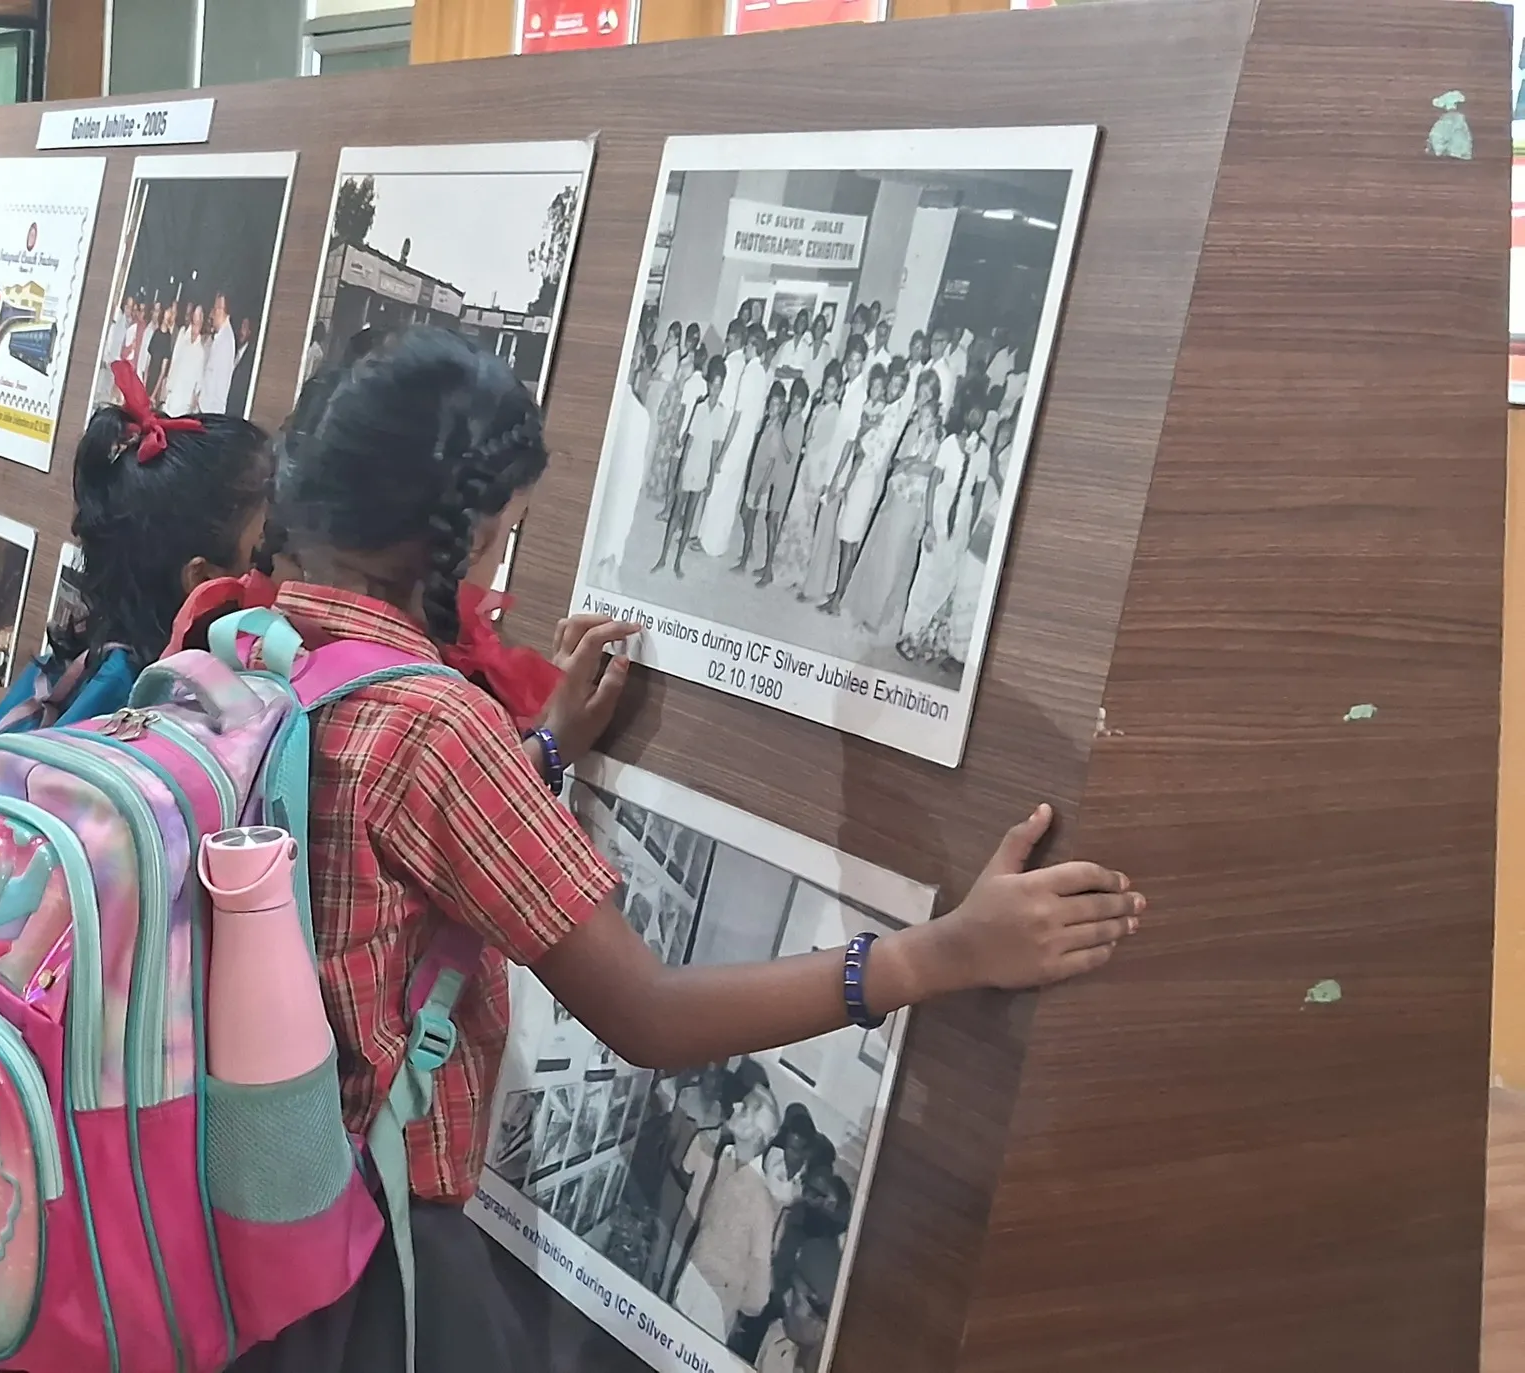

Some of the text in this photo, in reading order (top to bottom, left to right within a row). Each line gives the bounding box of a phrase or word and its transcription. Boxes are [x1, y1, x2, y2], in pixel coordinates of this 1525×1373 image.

[71, 117, 101, 140] Golden
[101, 114, 134, 139] Jubilee
[142, 111, 169, 137] 2005
[775, 215, 805, 230] SILVER
[734, 231, 855, 261] PHOTOGRAPHIC EXHIBITION
[582, 593, 950, 722] A view of the visitors during ICF Silver Jubilee Exhibition
[708, 660, 784, 701] 02.10.1980
[523, 1224, 574, 1274] exhibition
[575, 1266, 613, 1308] during
[614, 1293, 637, 1320] ICF
[637, 1312, 674, 1350] Silver
